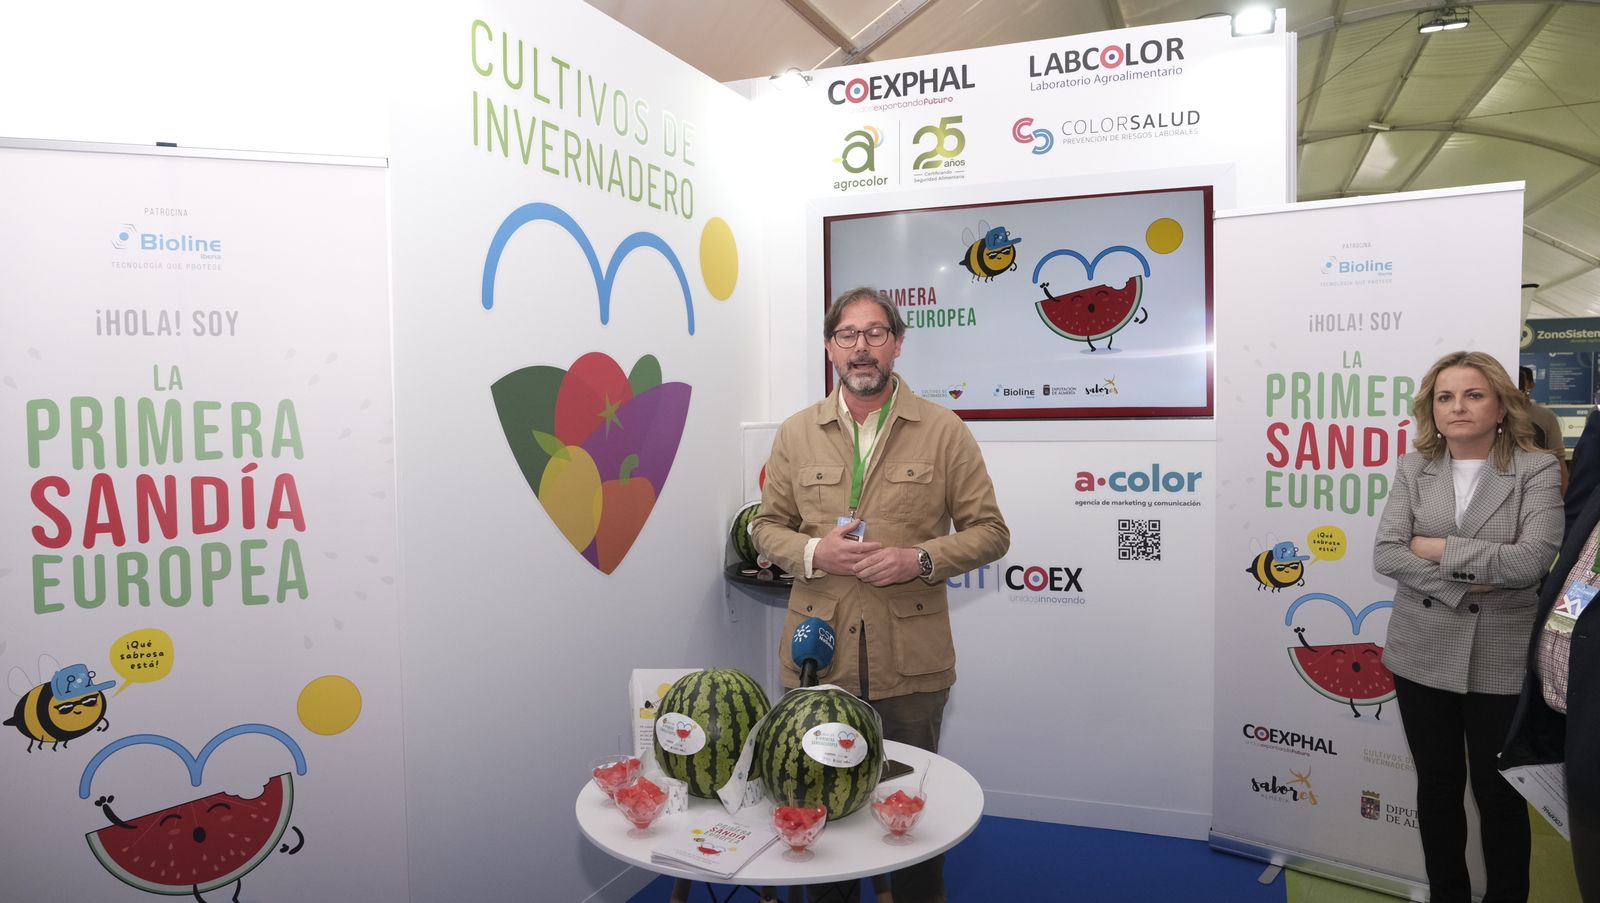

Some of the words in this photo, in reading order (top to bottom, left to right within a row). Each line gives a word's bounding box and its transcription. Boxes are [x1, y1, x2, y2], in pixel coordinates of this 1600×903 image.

[1029, 37, 1185, 78] LABCOLOR
[828, 64, 975, 105] COEXPHAL
[1030, 76, 1091, 91] Laboratorio
[1093, 66, 1183, 86] Agroalimentario
[471, 19, 649, 145] CULTIVOS
[662, 110, 695, 167] DE
[1061, 110, 1201, 136] COLORSALUD
[912, 115, 966, 170] 25
[1062, 134, 1108, 145] PREVENCIÓN
[1109, 133, 1119, 141] DE
[1121, 131, 1153, 140] RIESGOS
[1154, 127, 1199, 138] LABORALES
[473, 90, 694, 220] INVERNADERO
[943, 158, 966, 168] años
[833, 176, 889, 192] agrocolor
[144, 207, 188, 217] PATROCINA
[140, 233, 222, 252] Bioline
[1339, 259, 1393, 273] Bioline
[95, 309, 182, 337] ¡HOLA!
[192, 309, 240, 337] SOY
[906, 307, 977, 328] EUROPEA
[1308, 312, 1363, 333] ¡HOLA!
[1370, 310, 1403, 331] SOY
[1342, 350, 1363, 369] LA
[152, 364, 184, 391] LA
[1003, 387, 1035, 397] Bioline
[1266, 371, 1416, 420] PRIMER
[26, 395, 304, 471] PRIMERA
[1266, 419, 1411, 471] SANDÍ
[30, 462, 306, 549] SANDÍA
[1074, 499, 1100, 507] agencia
[1111, 499, 1147, 508] marketing
[1147, 500, 1153, 508] y
[1153, 499, 1202, 507] comunicación
[1265, 470, 1389, 517] EUROP
[32, 538, 309, 615] EUROPEA
[1005, 565, 1083, 592] COEX
[1009, 594, 1086, 605] unidosinnovando
[120, 651, 165, 660] sabrosa
[126, 639, 153, 651] ¡Qué
[130, 659, 159, 670] está!
[1243, 723, 1338, 756] COEXPHAL
[1386, 803, 1418, 819] DIPUT
[1386, 813, 1401, 825] DE
